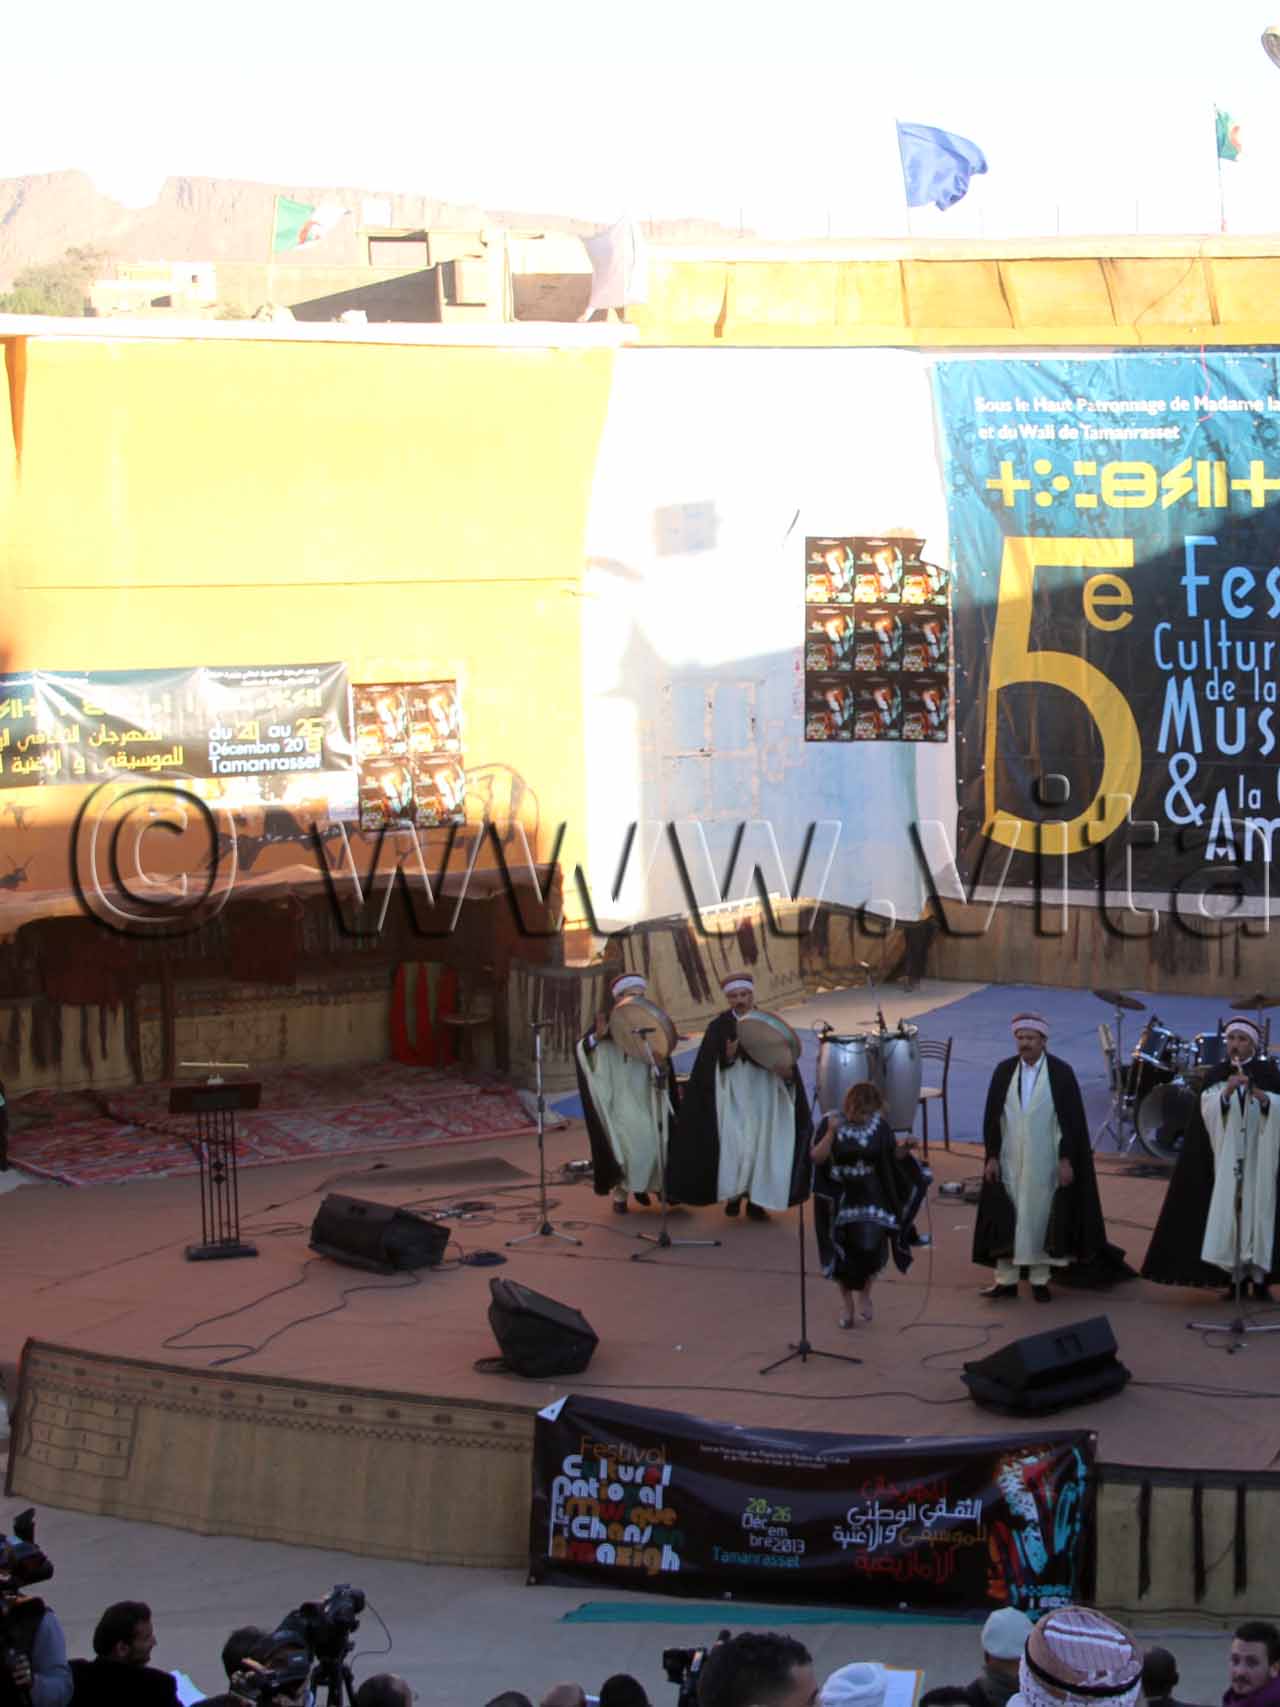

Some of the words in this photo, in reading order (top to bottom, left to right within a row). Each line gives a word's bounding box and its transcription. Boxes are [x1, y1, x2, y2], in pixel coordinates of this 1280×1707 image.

[976, 396, 1012, 413] Sous
[1016, 396, 1030, 412] le
[1034, 396, 1072, 412] Haut
[1170, 396, 1190, 412] de
[1194, 395, 1264, 412] Madame
[978, 426, 995, 440] et
[1000, 424, 1018, 440] du
[1019, 424, 1055, 440] Wali
[1058, 424, 1078, 440] de
[1079, 422, 1180, 440] Tamanrasset
[1205, 667, 1235, 701] de
[1254, 667, 1277, 702] la
[208, 721, 233, 740] du
[267, 724, 292, 738] au
[208, 738, 281, 756] Décembre
[208, 753, 322, 774] Tamanrasset
[1164, 751, 1205, 826] &
[1239, 775, 1261, 810] la
